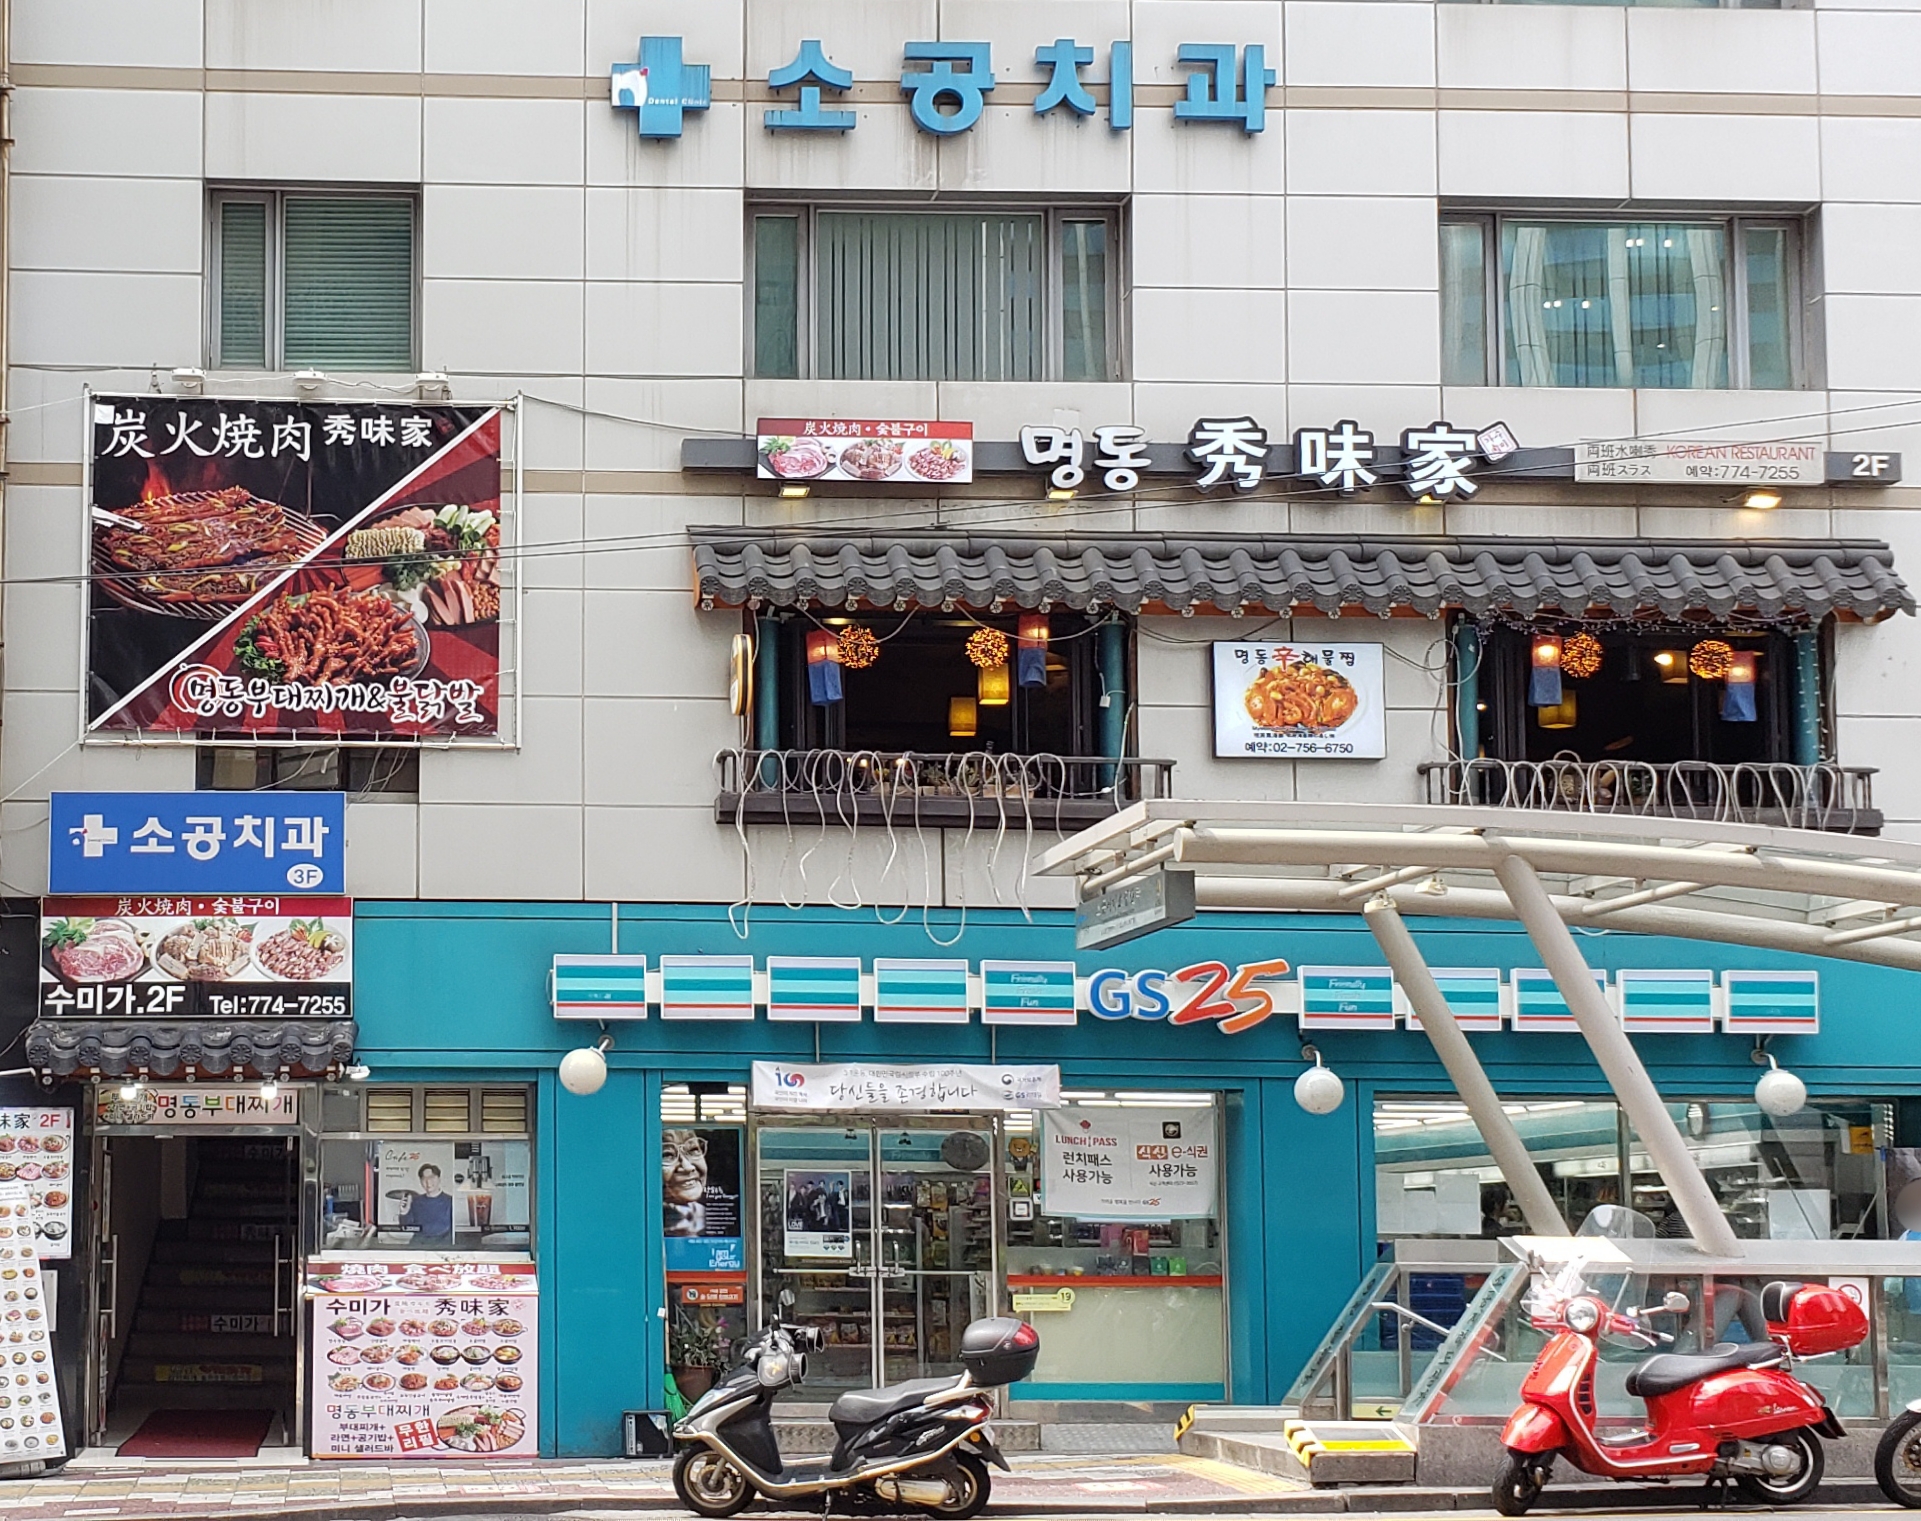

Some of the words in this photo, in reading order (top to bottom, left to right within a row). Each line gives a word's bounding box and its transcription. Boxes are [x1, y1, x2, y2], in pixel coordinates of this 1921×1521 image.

[764, 39, 1275, 134] 소공치과
[648, 97, 679, 106] Dental
[681, 97, 708, 106] Clinic
[101, 408, 311, 462] 炭火焼肉
[323, 413, 434, 448] 秀味家
[875, 424, 928, 437] 숯불구이
[1019, 424, 1150, 491] 명동
[1187, 417, 1481, 497] 秀味家
[1666, 445, 1727, 460] KOREAN
[1732, 445, 1815, 461] RESTAURANT
[1686, 466, 1800, 480] 예약:774-7255
[1851, 454, 1890, 477] 2F
[187, 676, 485, 723] 명동부대찌개&불닭발
[1245, 742, 1354, 754] 예약:02-756-6750
[130, 814, 330, 861] 소공치과
[293, 869, 318, 885] 3F
[211, 898, 280, 915] 숯불구이
[44, 984, 186, 1014] 수미가.2F
[209, 995, 346, 1015] Tel:774-7255
[1020, 997, 1039, 1007] Fun
[1086, 959, 1290, 1034] GS25
[1339, 1002, 1358, 1012] Fun
[830, 1081, 890, 1104] 당신들을
[895, 1082, 978, 1103] 존경합니다
[158, 1095, 293, 1118] 명동부대찌개
[40, 1114, 61, 1127] 2F
[1055, 1134, 1087, 1145] LUNCH
[1092, 1137, 1117, 1146] PASS
[1063, 1151, 1113, 1166] 런치패스
[1137, 1145, 1168, 1159] 식신
[1171, 1145, 1208, 1159] e-식권
[1063, 1169, 1113, 1184] 사용가능
[1149, 1164, 1198, 1178] 사용가능
[1060, 1292, 1071, 1301] 19
[326, 1298, 391, 1315] 수미가
[434, 1297, 510, 1316] 秀味家
[213, 1316, 259, 1331] 수미가
[327, 1404, 430, 1420] 명동부대찌개
[398, 1420, 429, 1436] 무한
[330, 1433, 394, 1442] 라면+공기밥+
[402, 1431, 434, 1449] 리필
[331, 1444, 350, 1453] 미니
